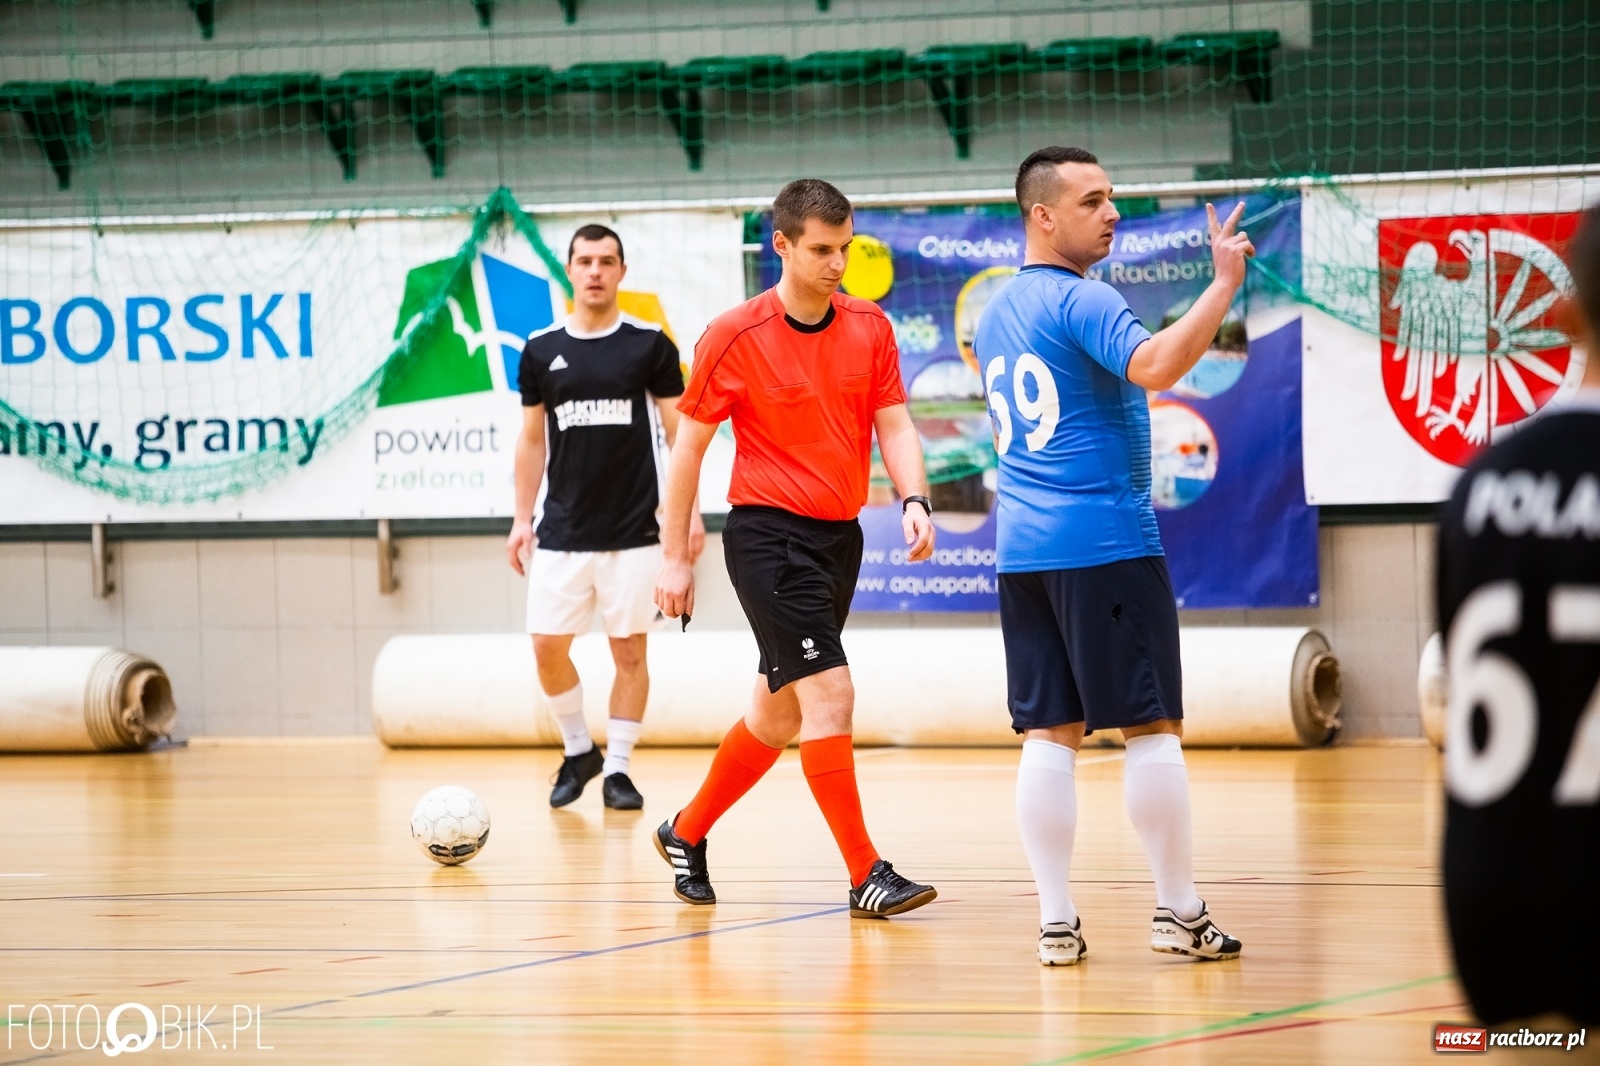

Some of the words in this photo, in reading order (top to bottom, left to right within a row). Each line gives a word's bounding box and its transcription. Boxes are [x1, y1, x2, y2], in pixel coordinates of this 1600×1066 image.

[918, 234, 1018, 259] Ośrodek
[0, 292, 313, 364] BORSKI
[134, 413, 325, 473] gramy
[375, 417, 499, 464] powiat
[376, 467, 485, 491] zielona
